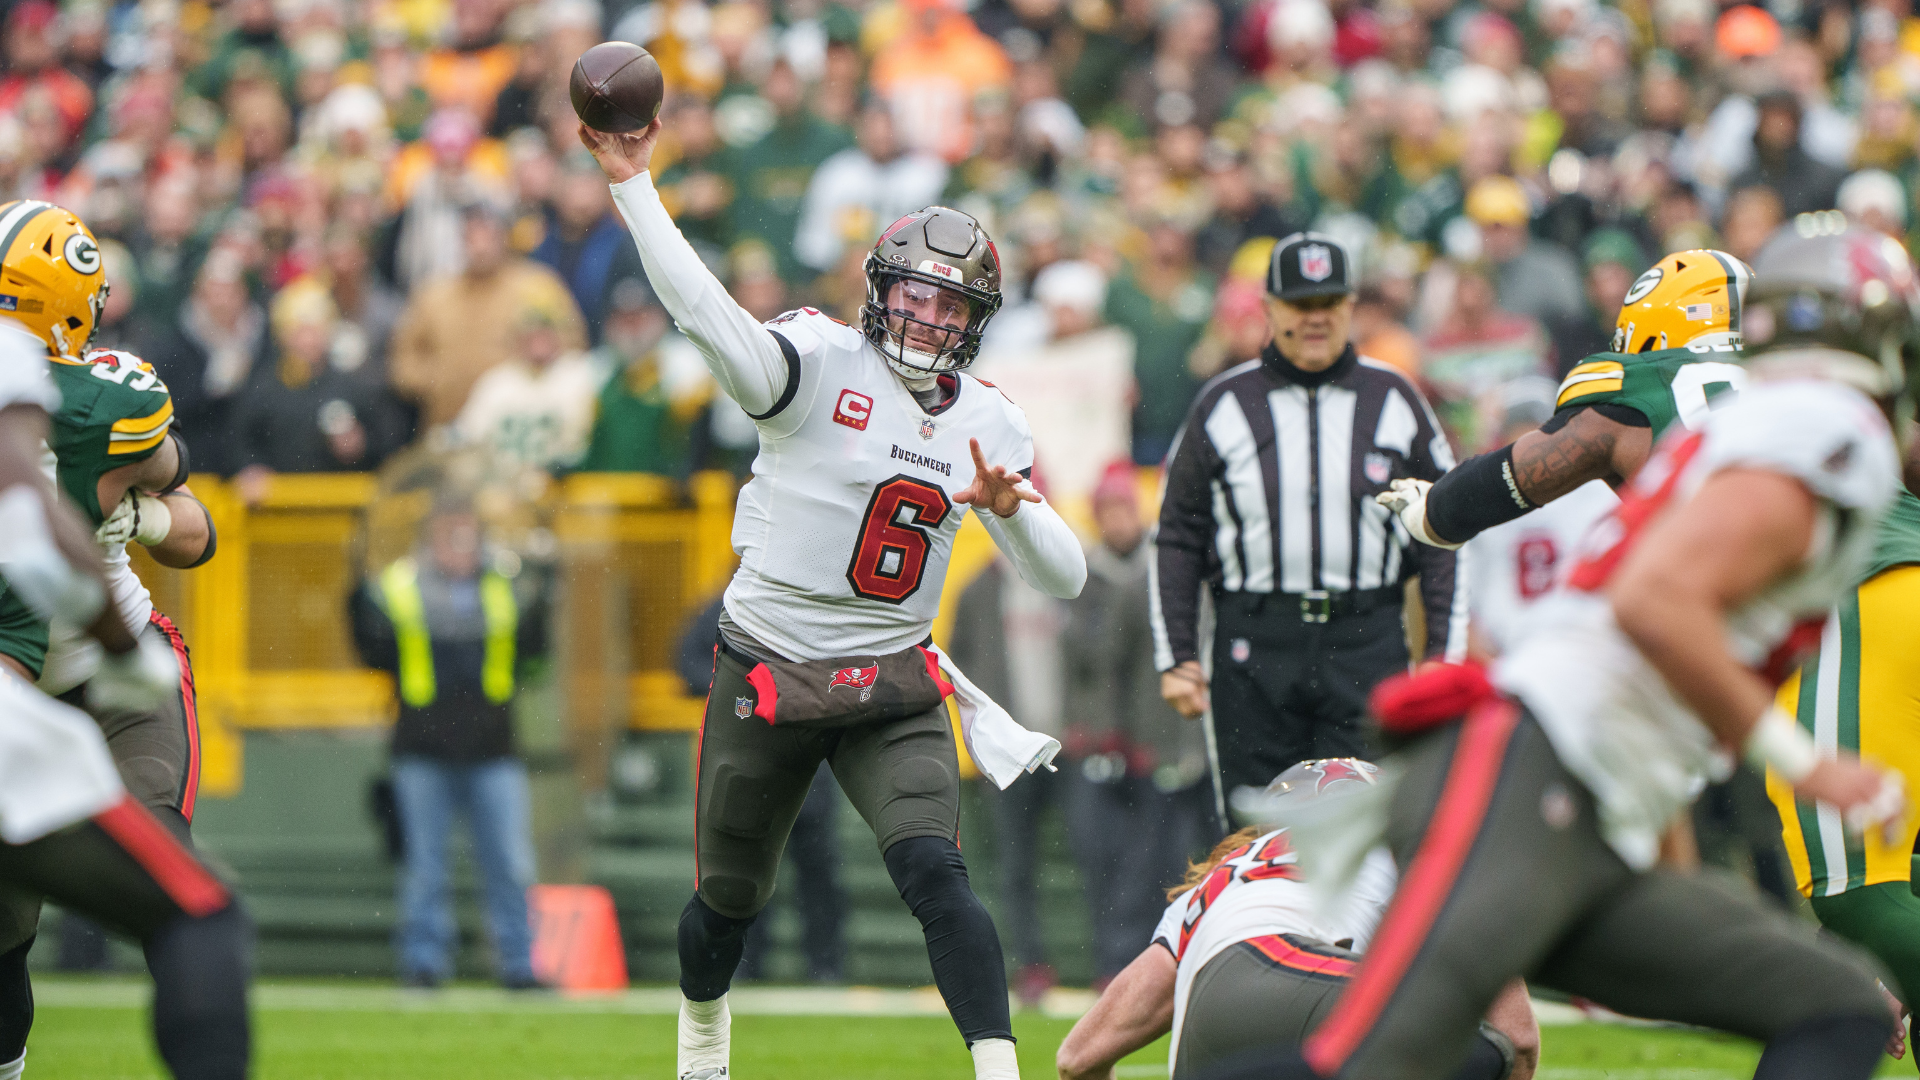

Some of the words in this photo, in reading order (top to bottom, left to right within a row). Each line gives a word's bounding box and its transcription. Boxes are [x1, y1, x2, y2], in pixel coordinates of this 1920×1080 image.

[839, 392, 871, 421] C
[920, 425, 934, 437] NFL
[889, 443, 952, 478] BUCCANEERS
[845, 472, 953, 606] 6
[737, 704, 750, 715] NFL
